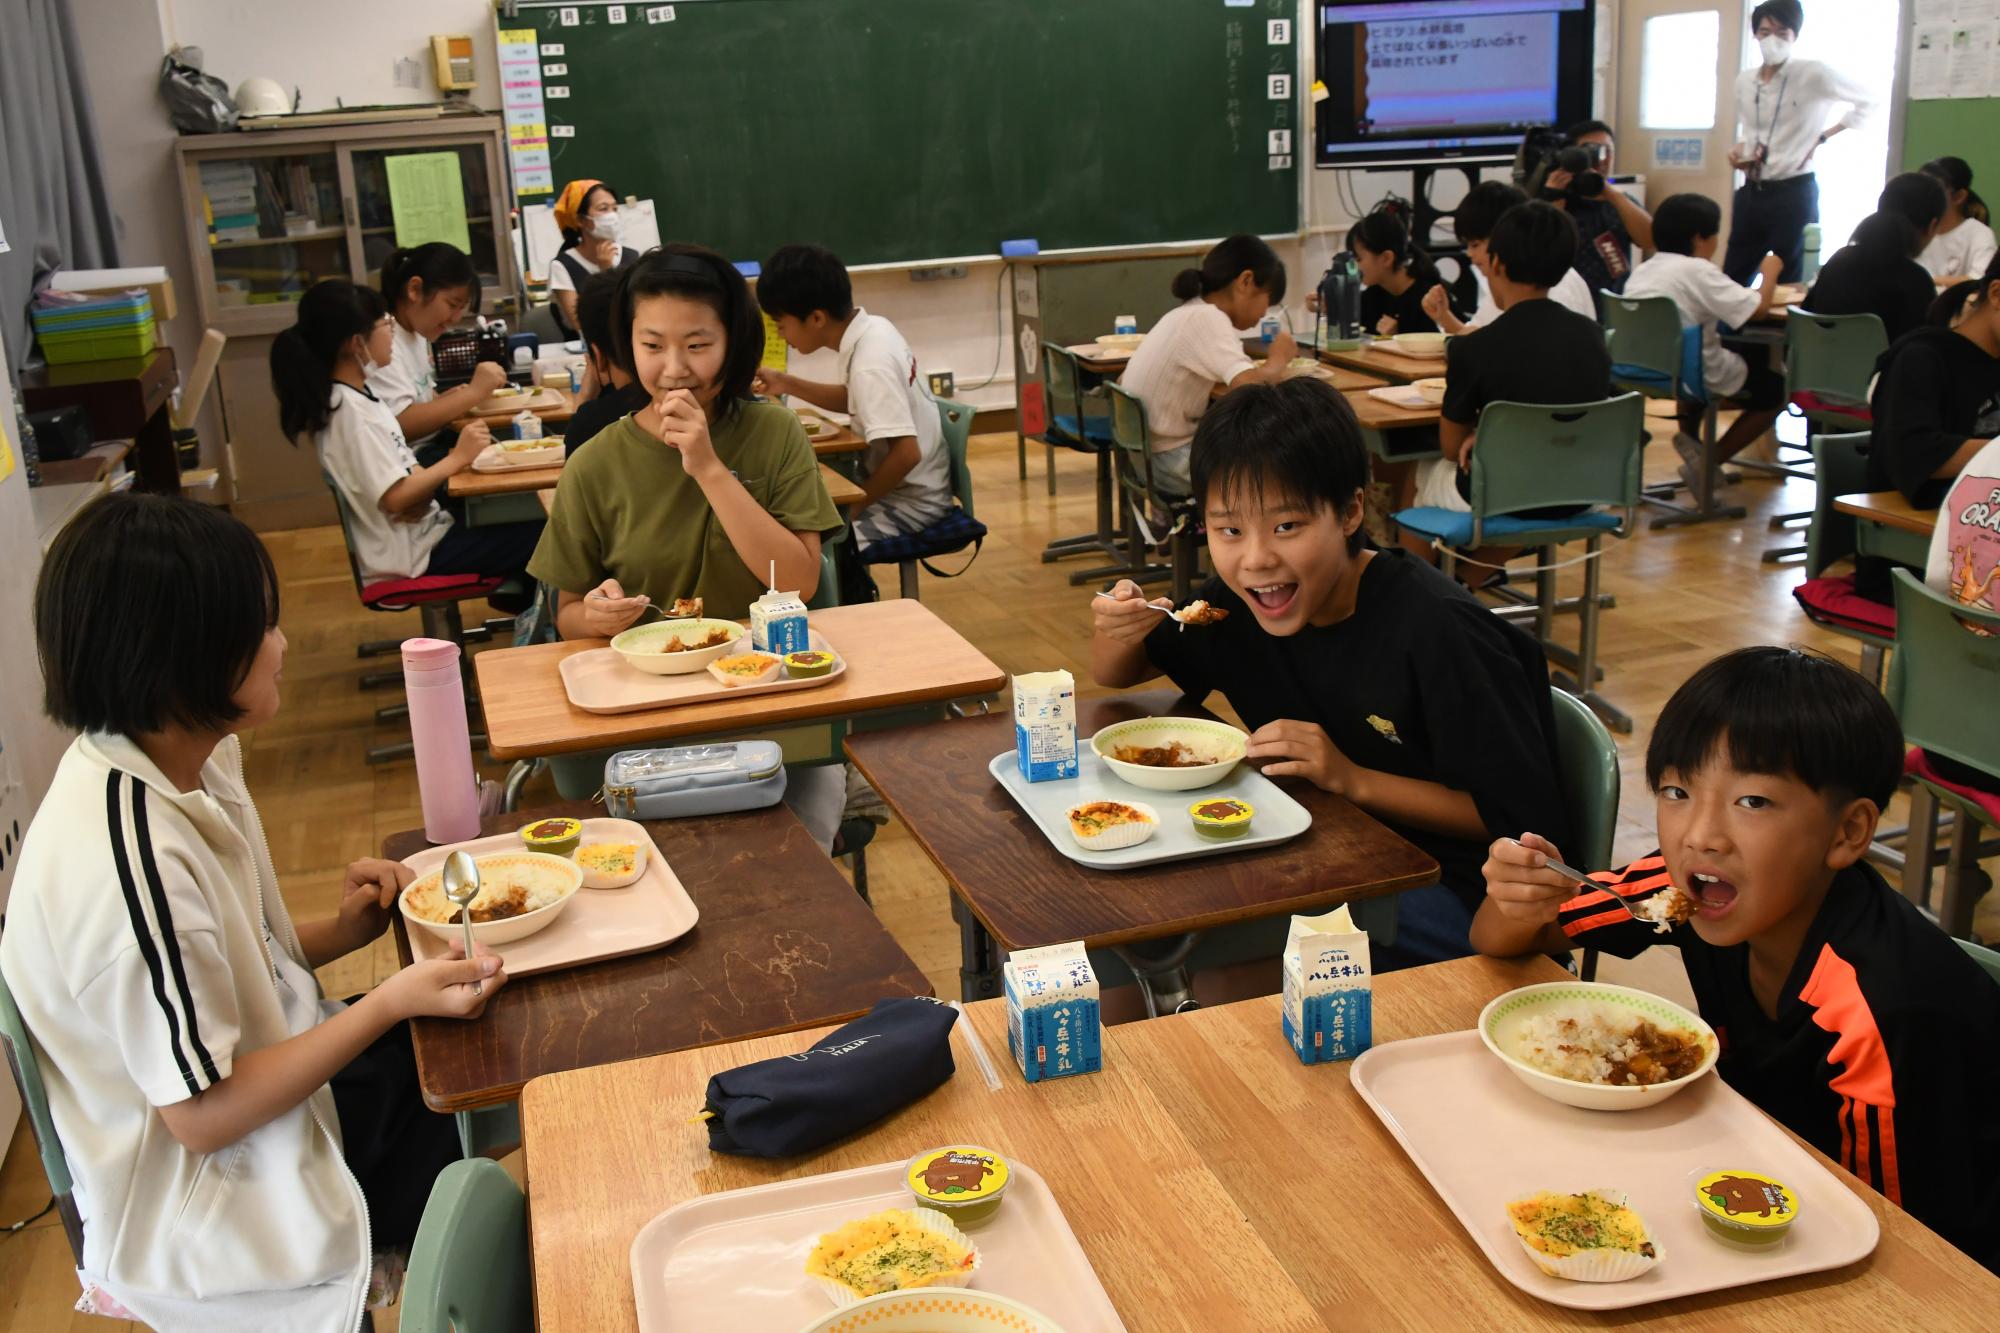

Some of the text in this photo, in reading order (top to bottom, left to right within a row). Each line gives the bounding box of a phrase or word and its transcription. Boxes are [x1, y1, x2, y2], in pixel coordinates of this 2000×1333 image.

[1601, 241, 1624, 272] NHK
[1960, 503, 2000, 534] ORA
[784, 621, 794, 653] 八ヶ岳牛
[1309, 964, 1365, 981] 八ヶ岳牛乳
[1053, 1007, 1073, 1072] 八ヶ岳牛乳
[1331, 997, 1347, 1056] 八ヶ岳牛乳
[831, 1039, 869, 1057] ITALIA
